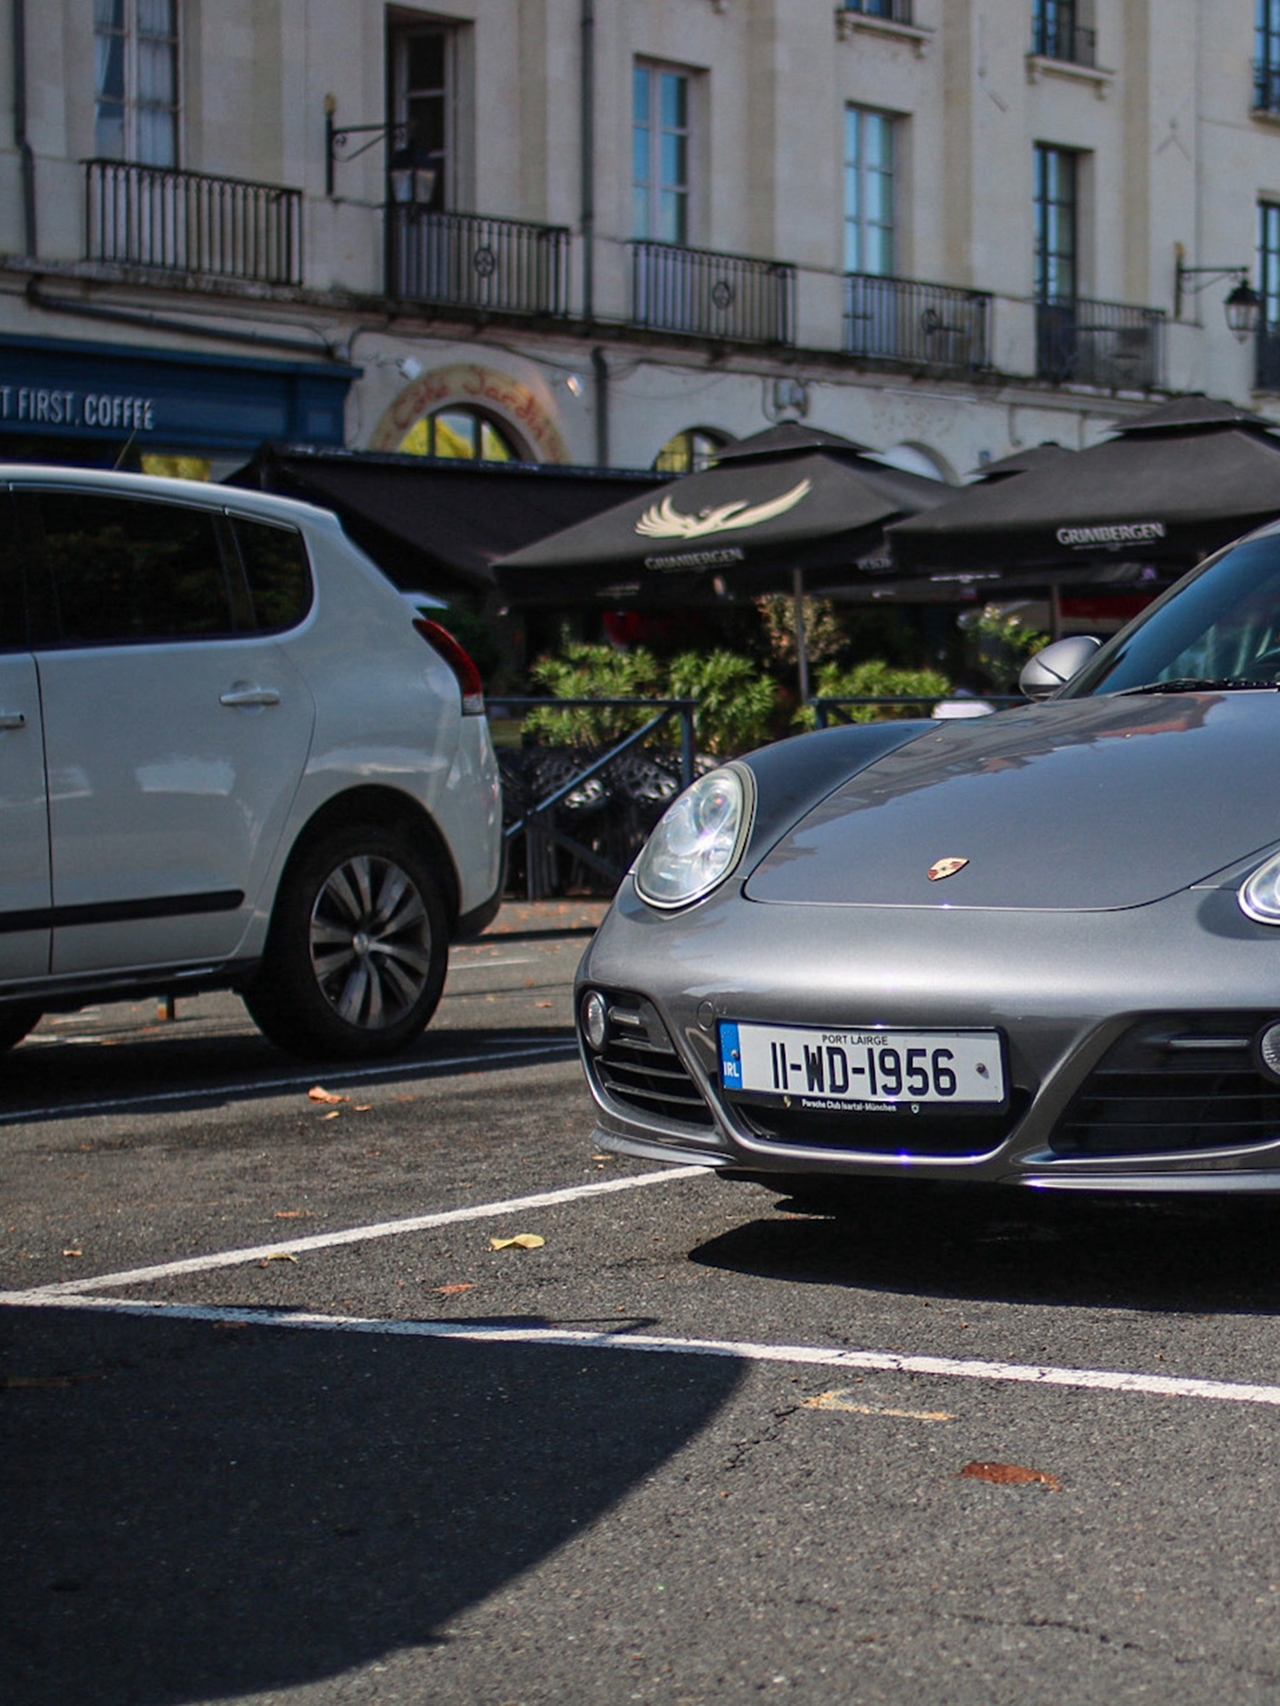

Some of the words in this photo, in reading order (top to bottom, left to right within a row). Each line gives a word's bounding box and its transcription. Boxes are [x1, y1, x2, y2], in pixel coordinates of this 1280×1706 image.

[84, 394, 154, 430] COFFEE
[1056, 521, 1166, 546] GRIMBERGEN
[644, 547, 745, 571] GRIMBERGEN
[822, 1034, 848, 1044] PORT
[723, 1061, 740, 1077] IRL
[770, 1042, 957, 1096] 11-WD-1956
[801, 1098, 826, 1109] Porsche
[826, 1099, 840, 1110] Club
[842, 1101, 898, 1112] Isartal-München
